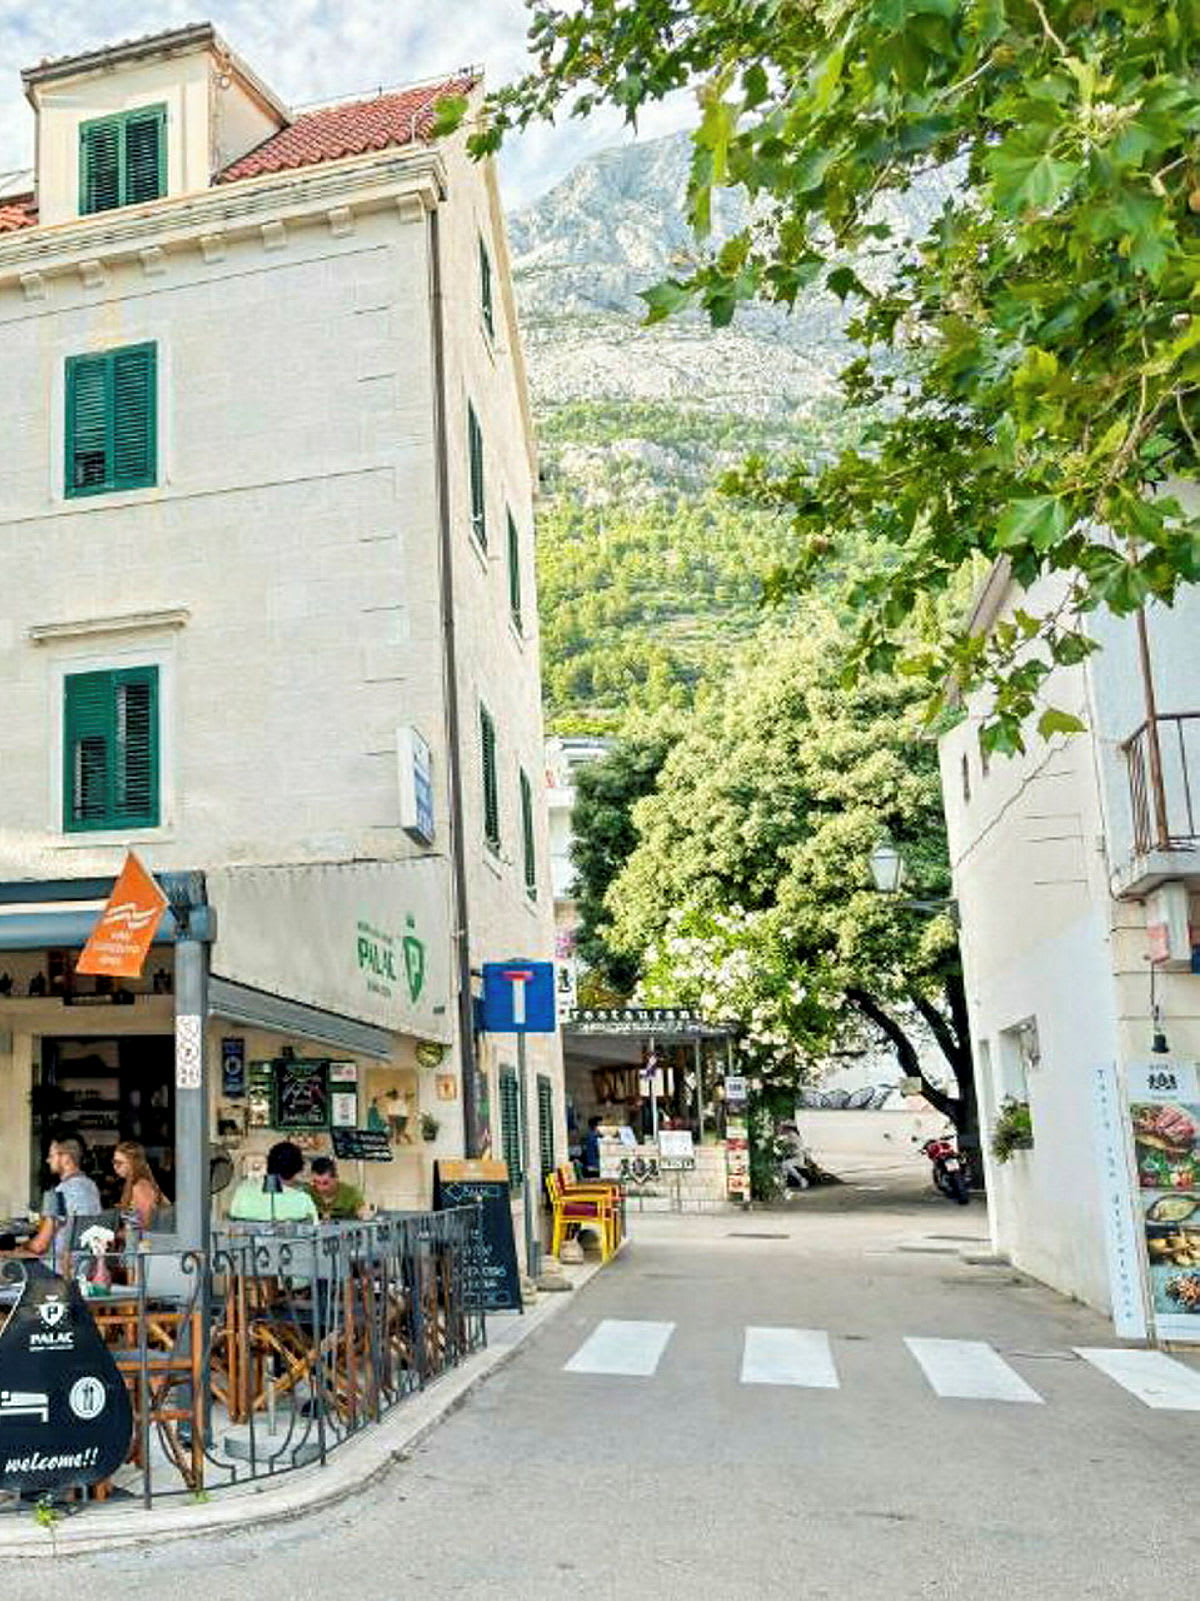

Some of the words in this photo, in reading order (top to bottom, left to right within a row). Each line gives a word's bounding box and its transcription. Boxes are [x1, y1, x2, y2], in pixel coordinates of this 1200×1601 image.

[572, 1009, 702, 1020] restaurant
[30, 1332, 74, 1345] PALAC
[5, 1446, 99, 1473] welcome!!
